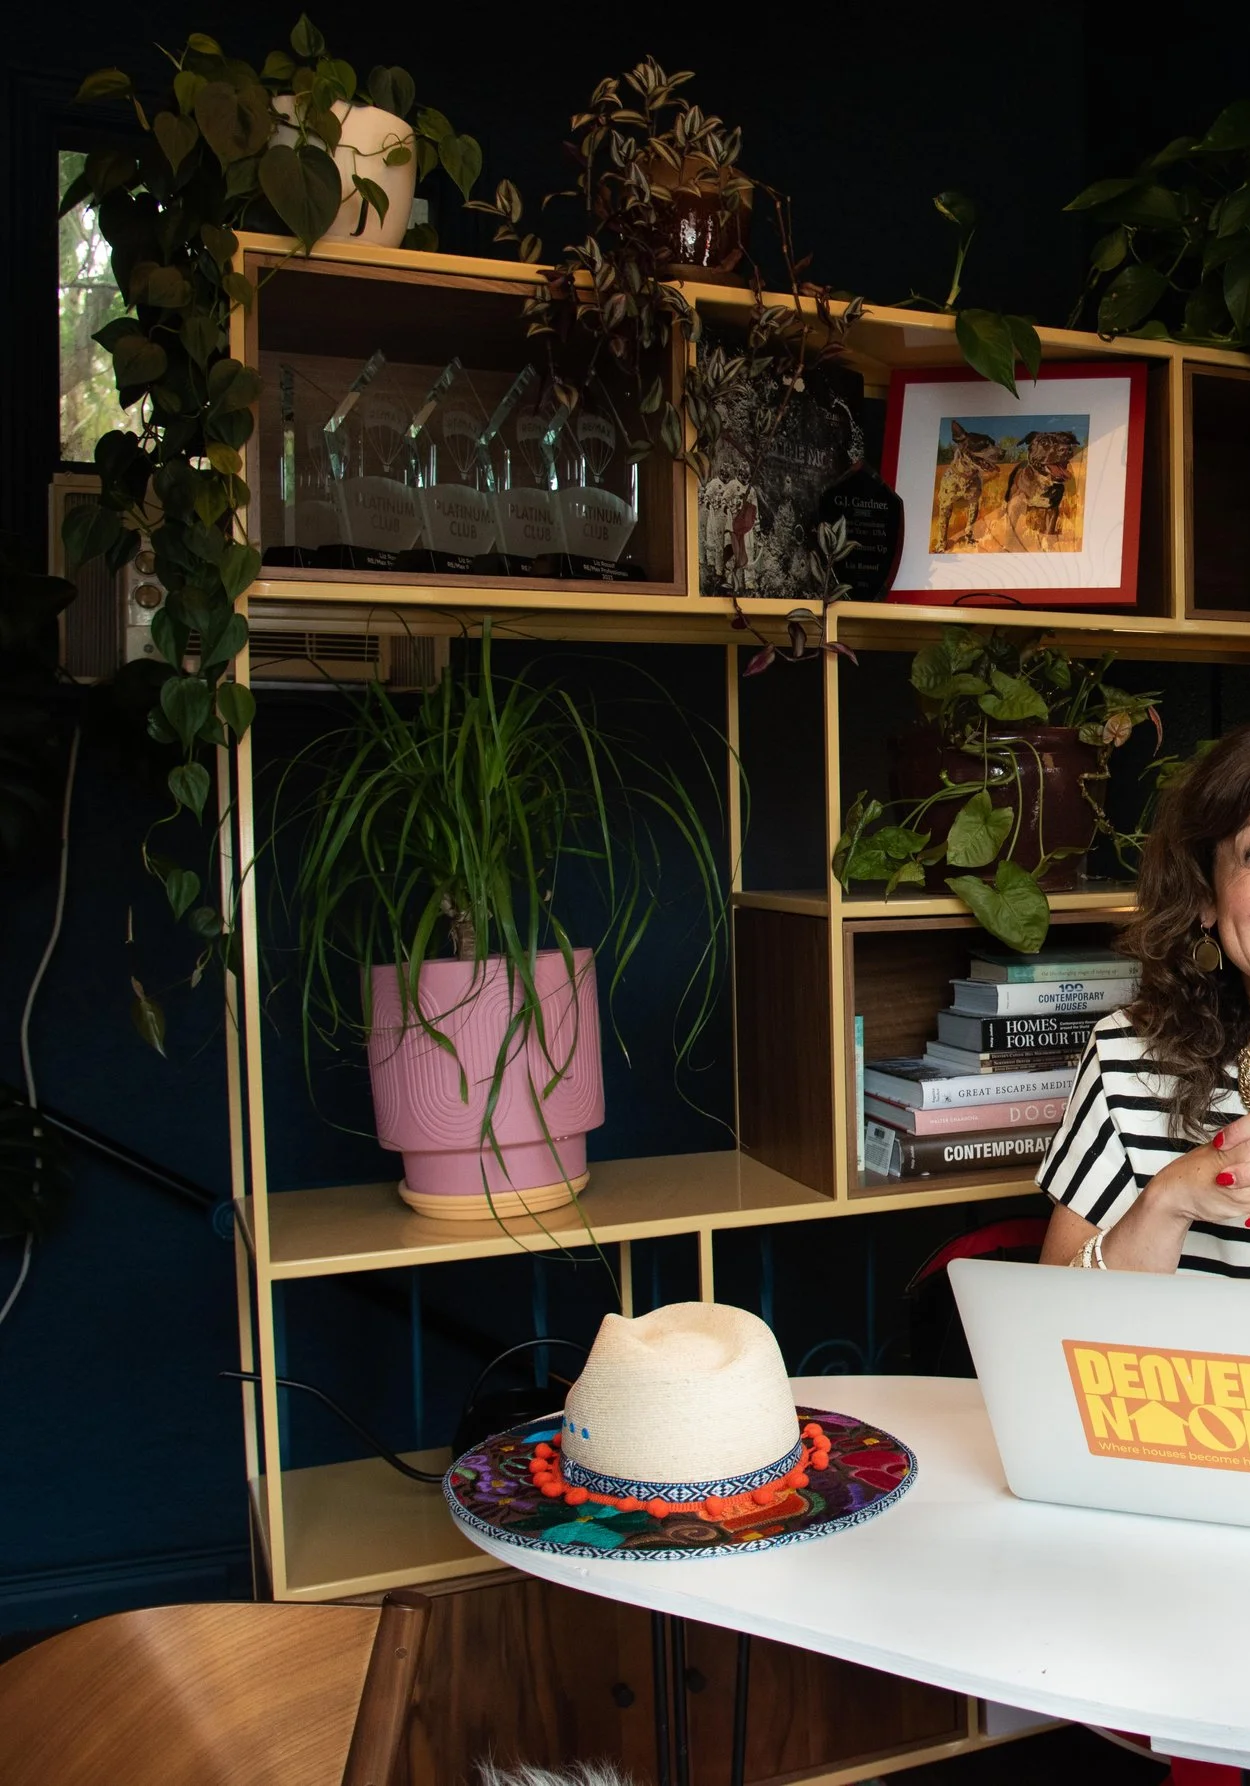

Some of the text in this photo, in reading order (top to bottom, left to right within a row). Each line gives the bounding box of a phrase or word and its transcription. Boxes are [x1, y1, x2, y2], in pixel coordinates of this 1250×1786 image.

[435, 499, 490, 524] PLATINUM
[370, 513, 400, 533] CLUB
[449, 520, 478, 540] CLUB
[582, 522, 609, 540] CLUB
[523, 523, 550, 542] CLUB
[1038, 991, 1105, 1003] CONTEMPORARY
[1059, 983, 1084, 993] 100
[1055, 1002, 1087, 1011] HOUSES
[1006, 1018, 1057, 1034] HOMES
[1006, 1030, 1090, 1048] FOR OUR TI
[958, 1080, 1073, 1098] GREAT ESCAPES MEDIT
[1099, 1440, 1139, 1454] Where
[1143, 1446, 1186, 1460] houses
[1189, 1451, 1240, 1466] become
